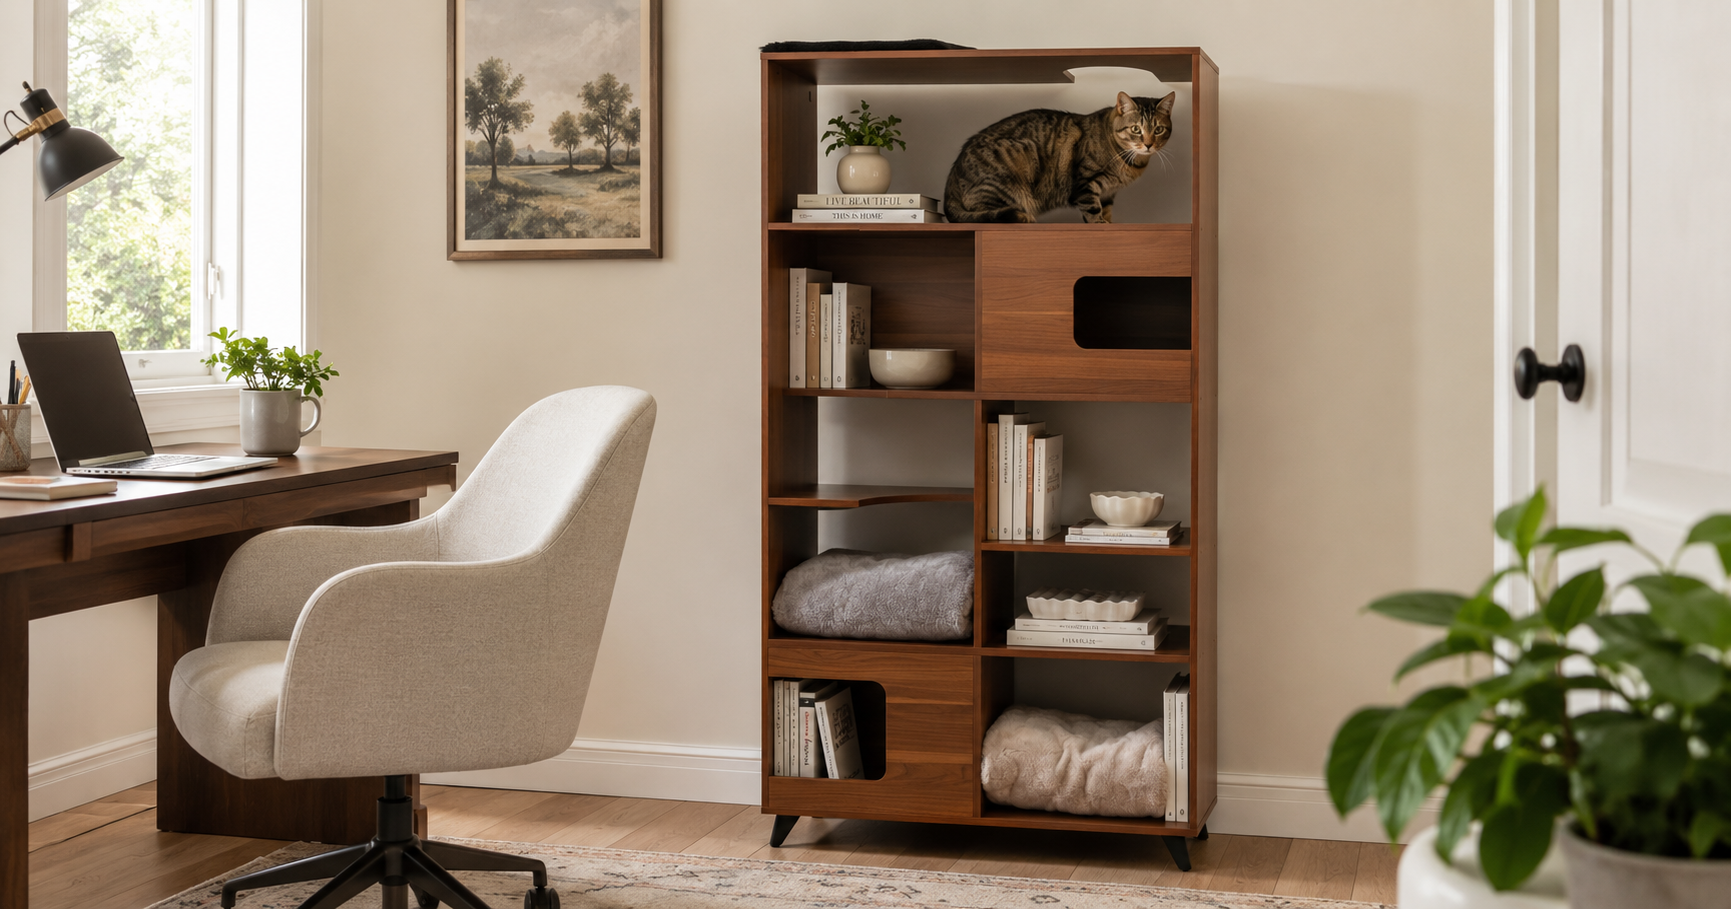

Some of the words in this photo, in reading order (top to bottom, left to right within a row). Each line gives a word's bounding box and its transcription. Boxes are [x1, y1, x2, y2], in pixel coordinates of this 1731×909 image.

[825, 197, 847, 206] LIVE
[849, 197, 901, 206] BEAUTIFUL
[832, 212, 850, 220] THIS
[851, 212, 859, 220] IS
[860, 212, 884, 220] HOME
